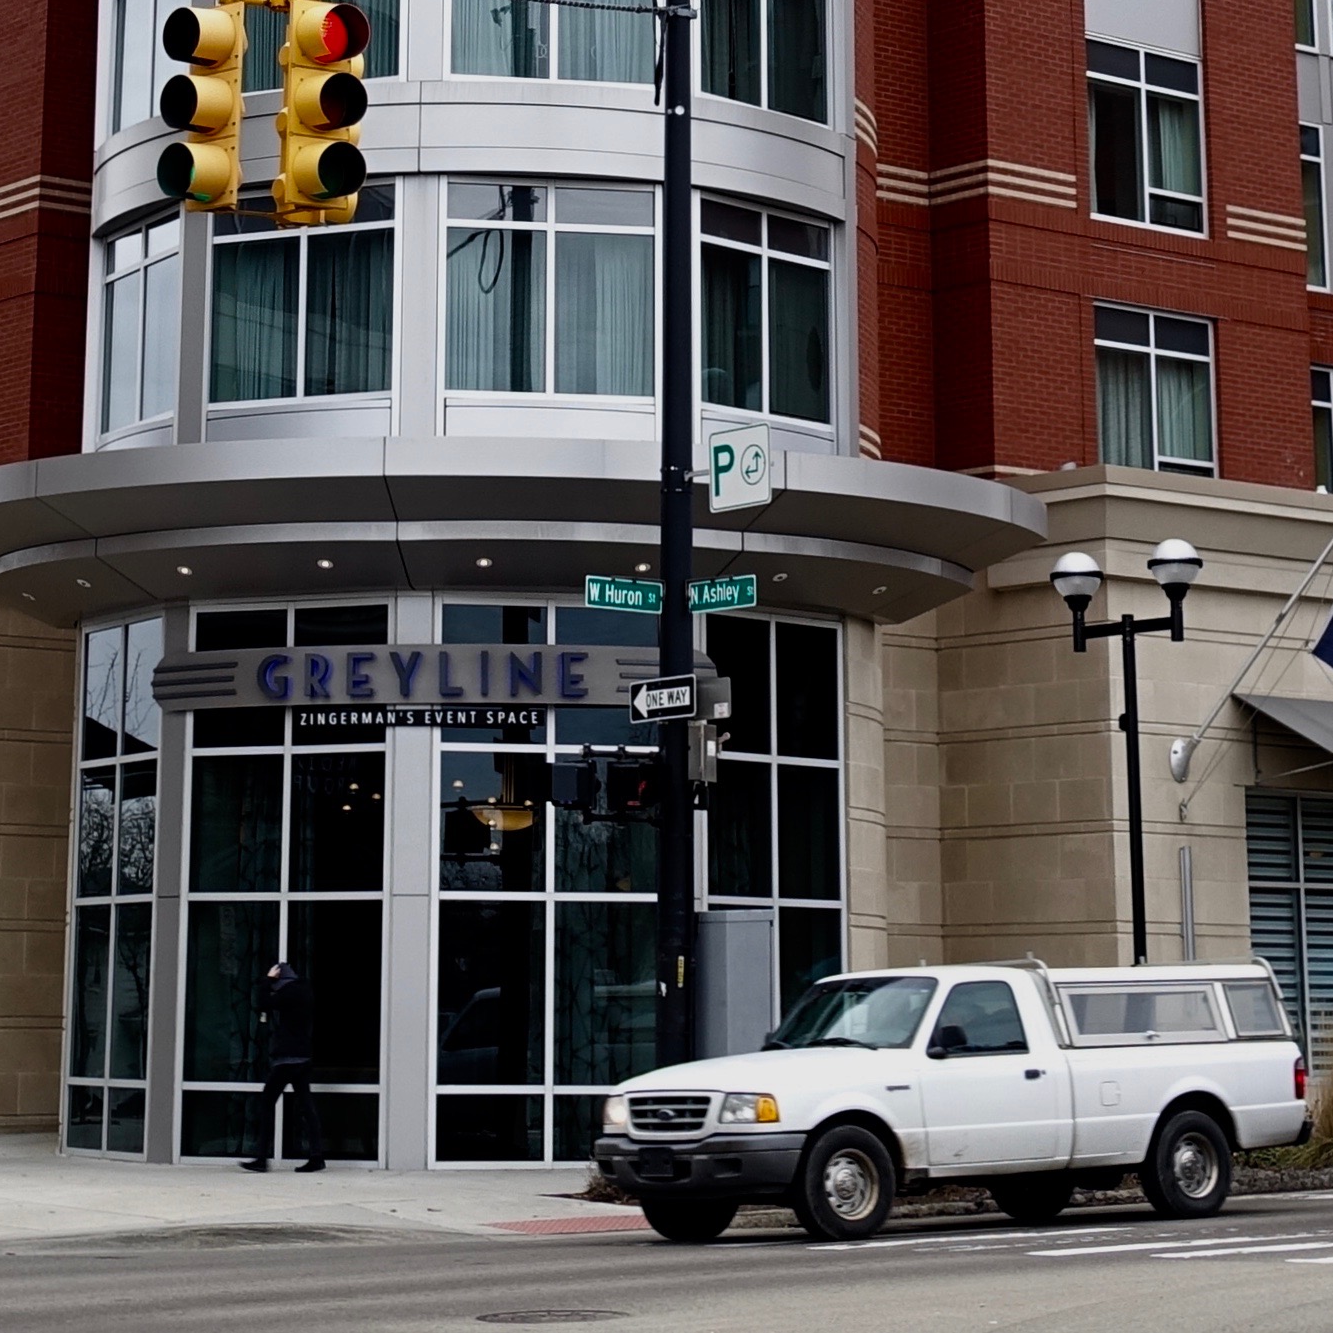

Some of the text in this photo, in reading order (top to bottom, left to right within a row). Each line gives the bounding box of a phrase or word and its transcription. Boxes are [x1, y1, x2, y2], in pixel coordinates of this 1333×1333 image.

[713, 444, 735, 497] P
[605, 584, 642, 606] Huron
[648, 593, 656, 604] St
[703, 582, 740, 604] Ashley
[256, 650, 588, 699] GREYLINE
[646, 688, 687, 708] ONE WAY
[300, 711, 538, 725] ZINGERMAN'S EVENT SPACE
